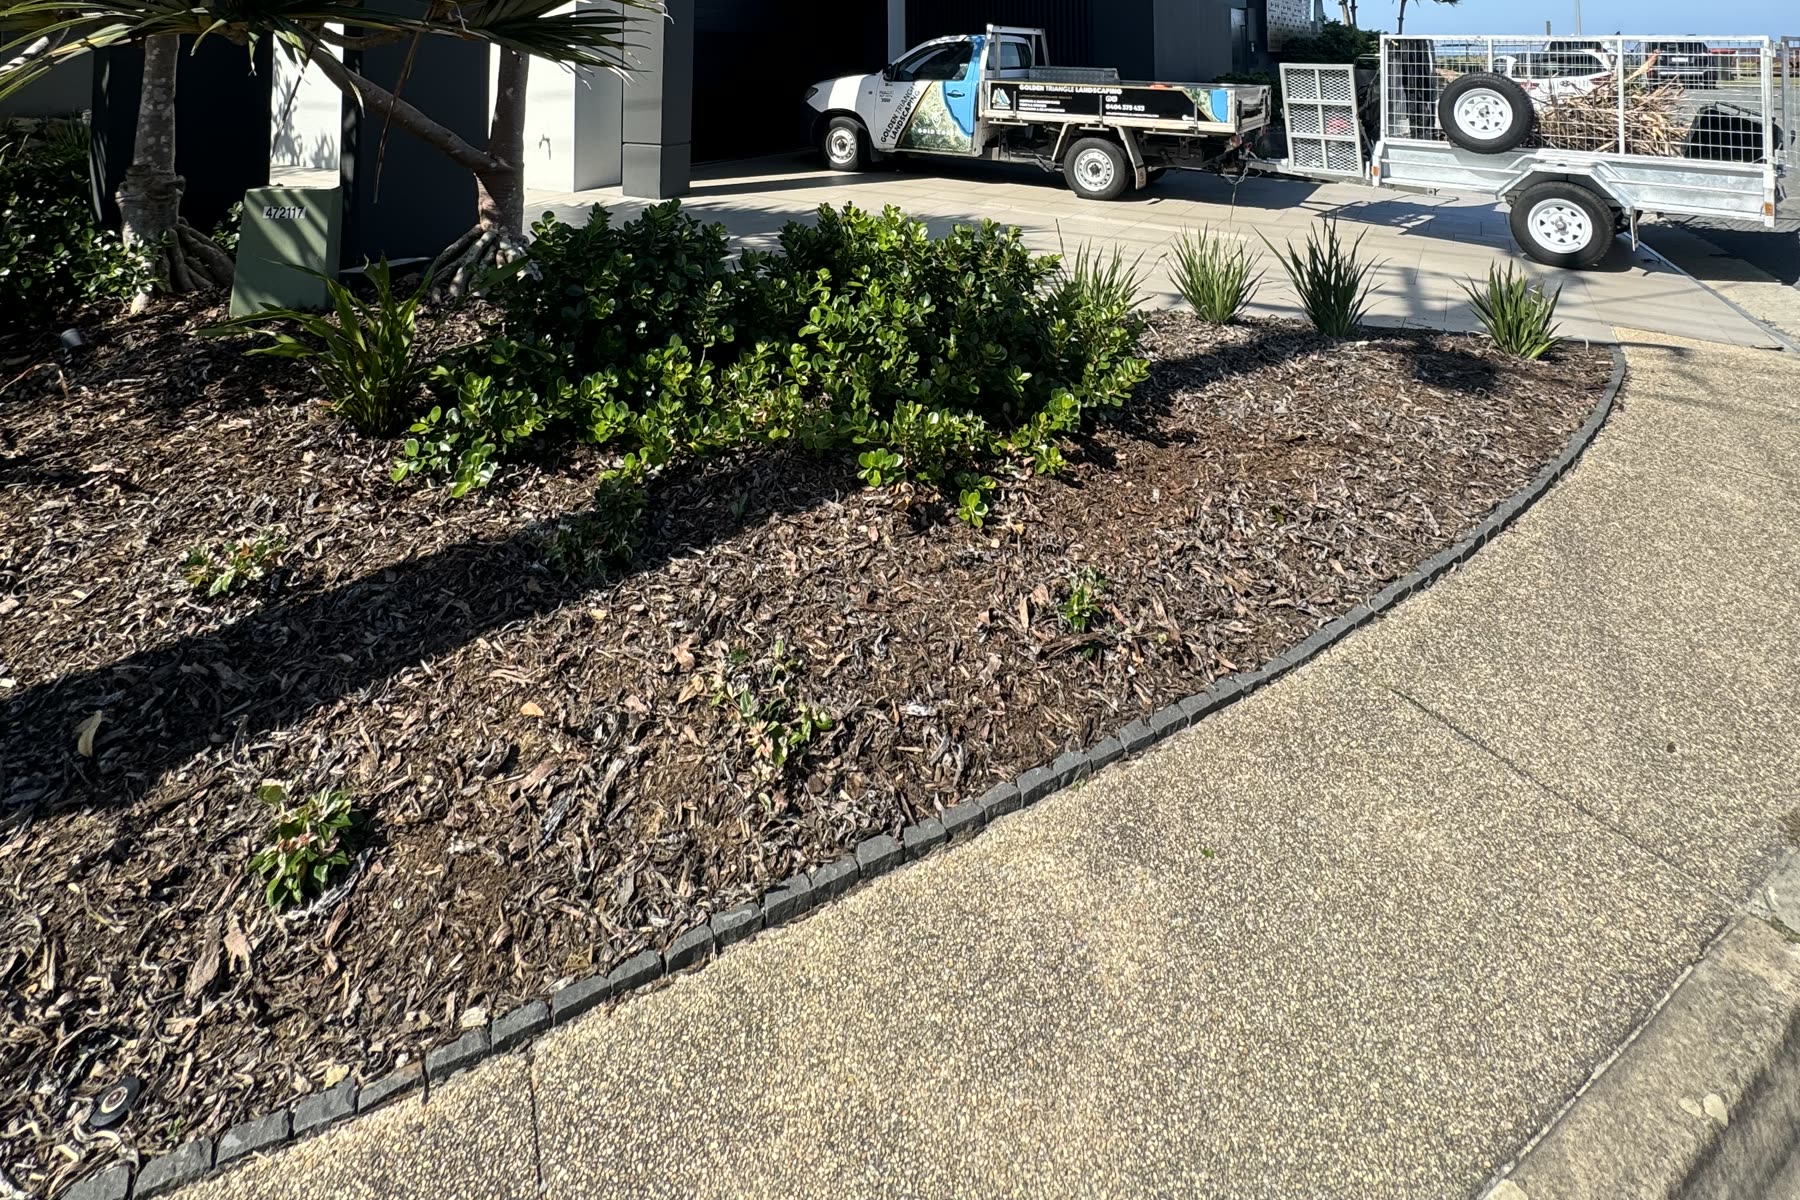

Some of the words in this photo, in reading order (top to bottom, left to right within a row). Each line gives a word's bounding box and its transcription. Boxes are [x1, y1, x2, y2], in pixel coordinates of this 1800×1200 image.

[1045, 85, 1074, 93] TRIANGLE
[1075, 86, 1122, 95] LANDSCAPING
[890, 90, 921, 140] LANDSCAPING
[881, 114, 898, 143] GOLDEN
[265, 206, 304, 219] 472117
